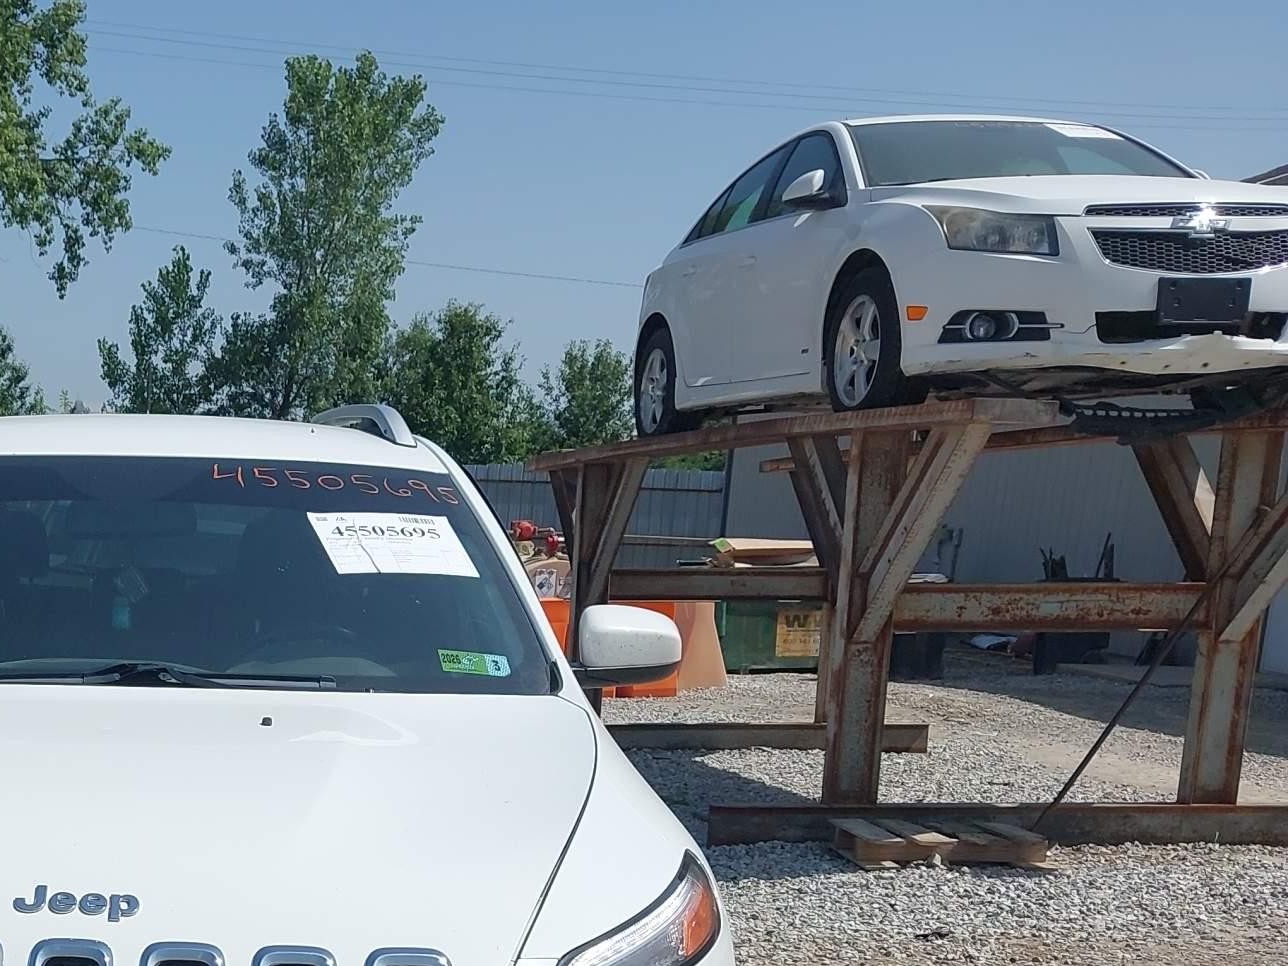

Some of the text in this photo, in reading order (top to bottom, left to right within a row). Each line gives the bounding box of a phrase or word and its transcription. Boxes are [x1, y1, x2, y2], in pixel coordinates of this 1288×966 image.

[213, 463, 459, 504] 45505695
[331, 525, 441, 540] 45505695
[492, 660, 501, 671] 3
[13, 885, 140, 922] Jeep
